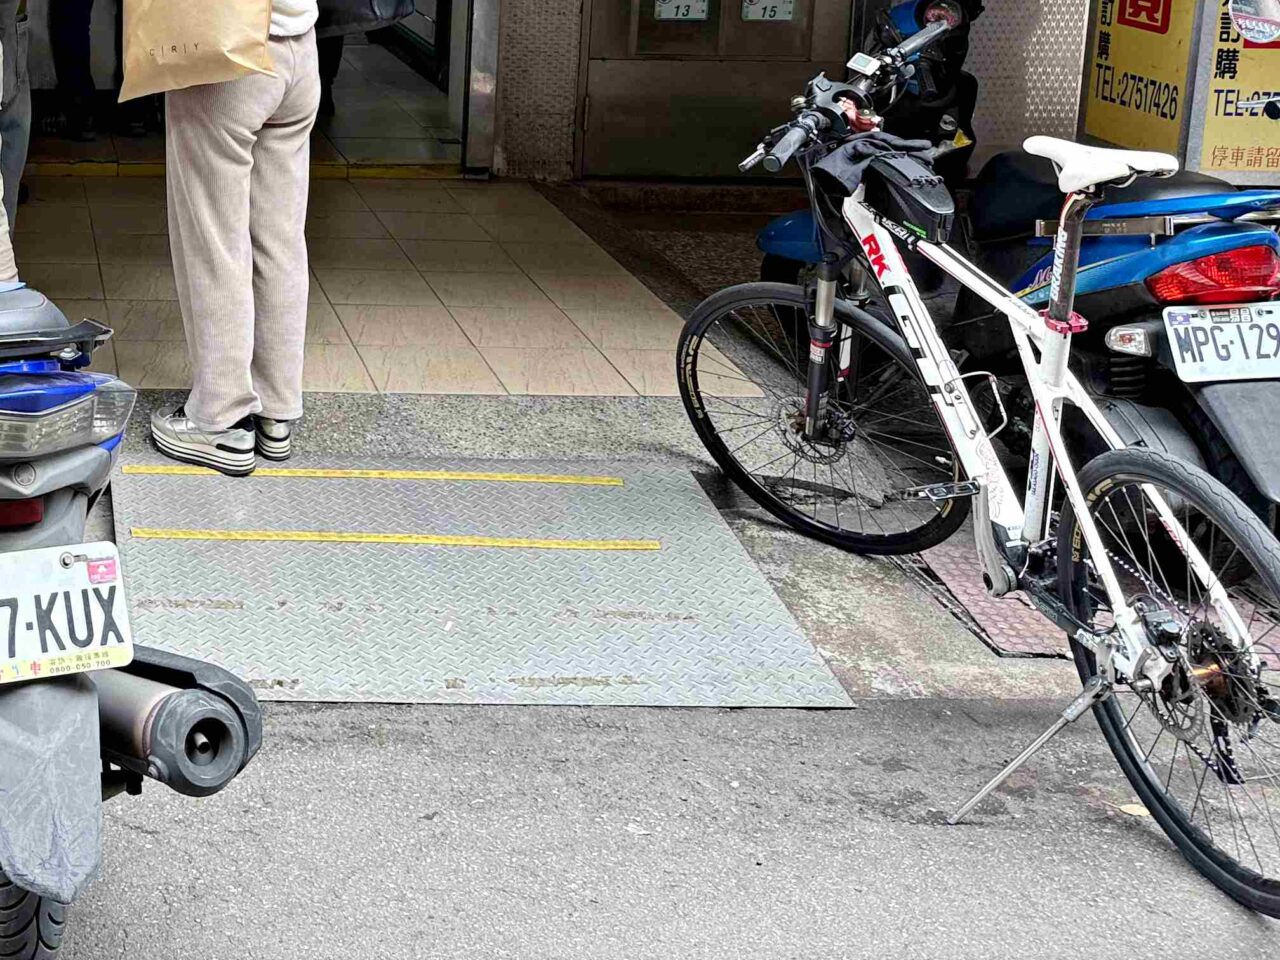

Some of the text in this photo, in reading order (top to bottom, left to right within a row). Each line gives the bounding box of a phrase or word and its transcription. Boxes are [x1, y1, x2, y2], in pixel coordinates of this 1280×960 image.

[674, 5, 691, 17] 13
[761, 5, 778, 18] 15
[1095, 62, 1179, 121] TEL:27517426
